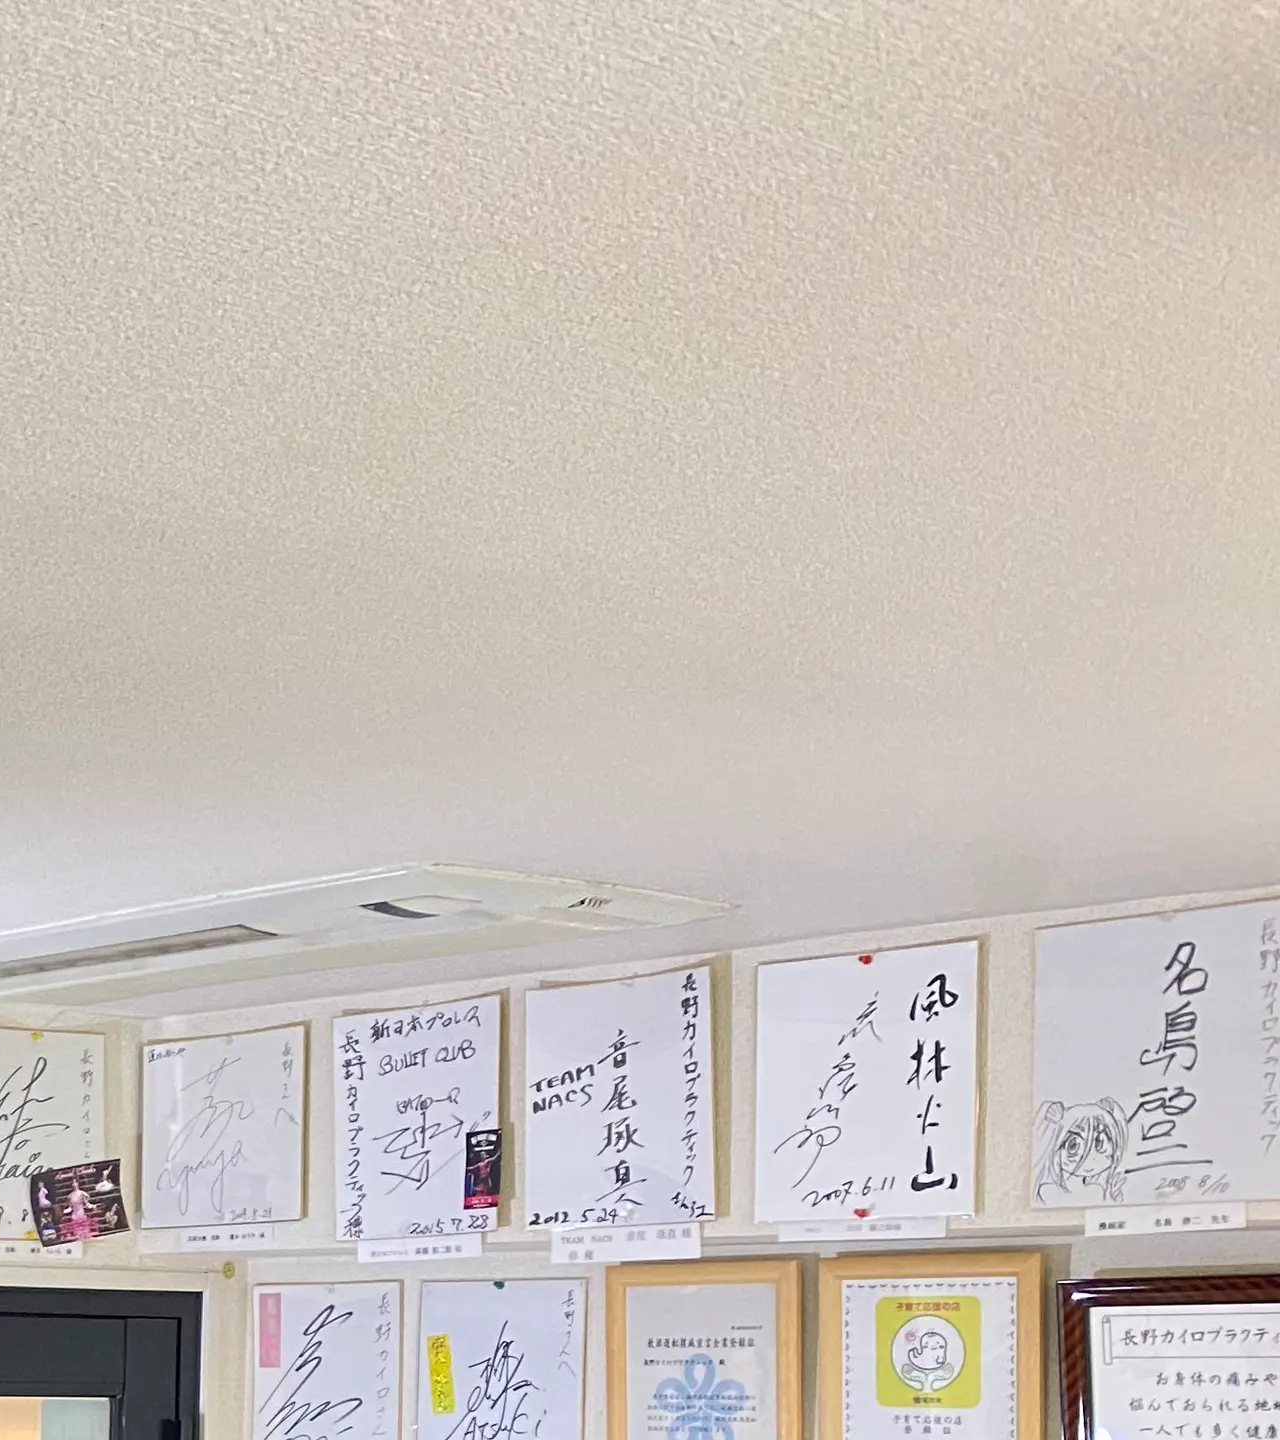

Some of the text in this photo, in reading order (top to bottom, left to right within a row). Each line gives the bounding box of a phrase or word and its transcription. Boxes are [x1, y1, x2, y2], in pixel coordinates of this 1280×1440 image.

[370, 1006, 480, 1043] 新日本プロレス
[530, 1064, 595, 1093] TEAM
[532, 1085, 593, 1114] NACS
[896, 1301, 960, 1312] 子育て応援の店
